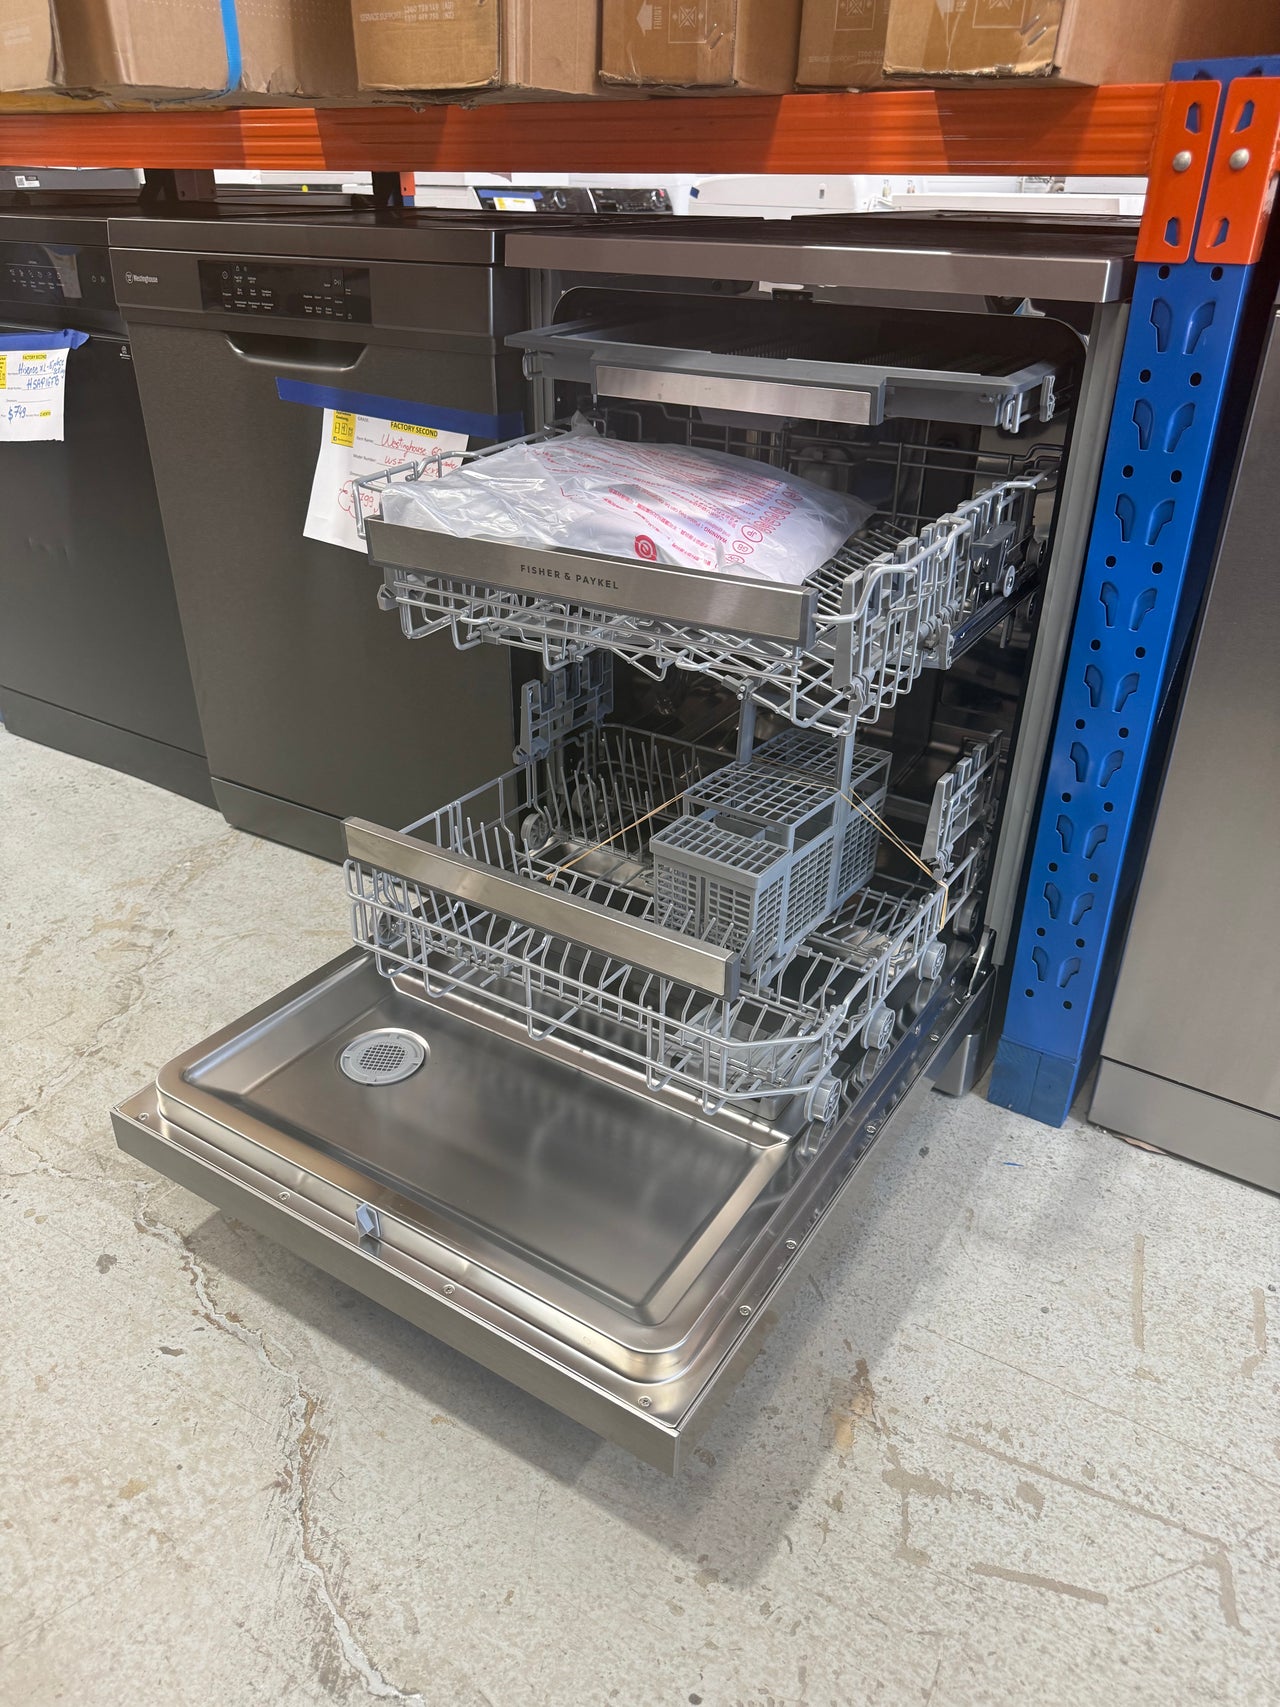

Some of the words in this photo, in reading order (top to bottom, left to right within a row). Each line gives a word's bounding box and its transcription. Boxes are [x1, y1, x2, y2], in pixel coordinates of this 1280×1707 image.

[390, 421, 416, 434] FACTORY
[415, 426, 438, 437] SECOND
[381, 433, 427, 458] Westinghouse
[703, 527, 728, 545] WARNING
[746, 530, 758, 538] JP
[736, 543, 750, 552] GB
[520, 564, 560, 579] FISHER
[564, 572, 571, 581] &
[575, 574, 619, 590] PAYKEL
